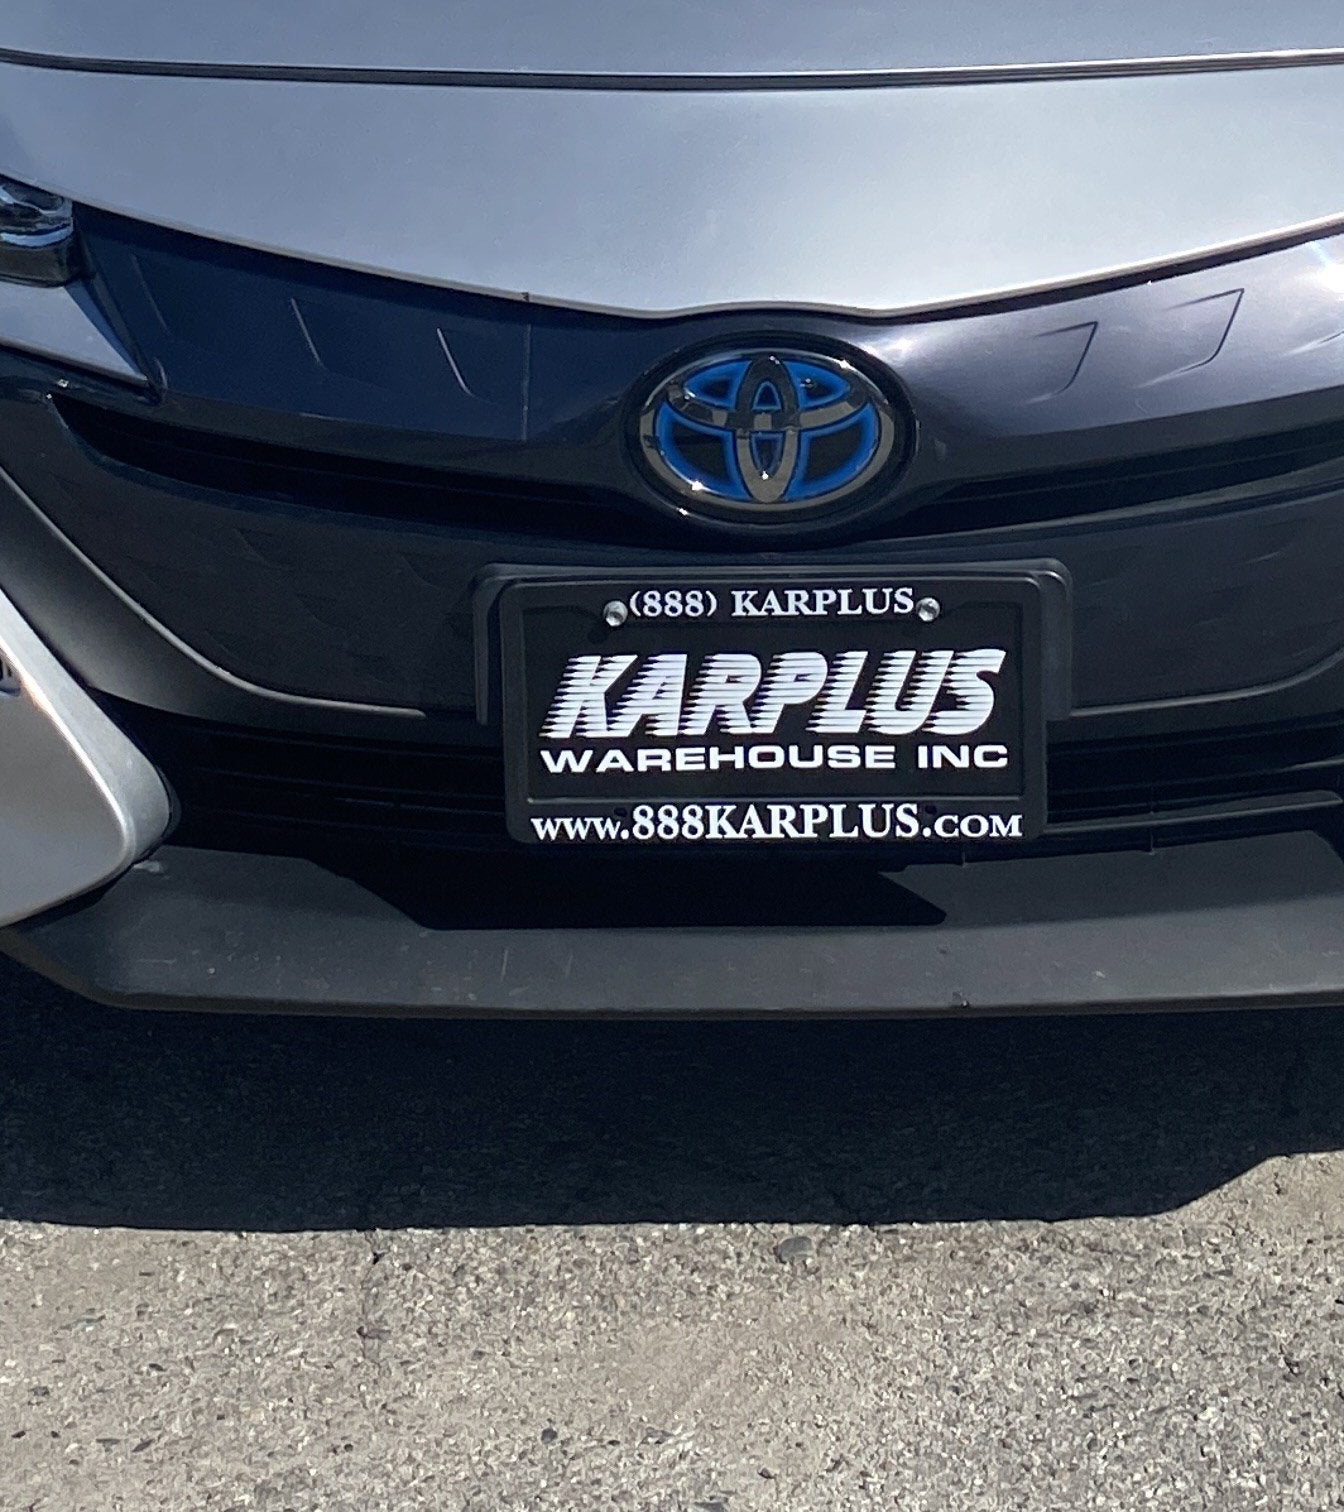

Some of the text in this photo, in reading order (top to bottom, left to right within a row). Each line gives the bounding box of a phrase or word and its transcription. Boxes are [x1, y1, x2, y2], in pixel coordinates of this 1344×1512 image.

[629, 587, 914, 617] (888) KARPLUS
[539, 648, 1006, 739] KARPLUS
[540, 744, 1008, 773] WAREHOUSE INC
